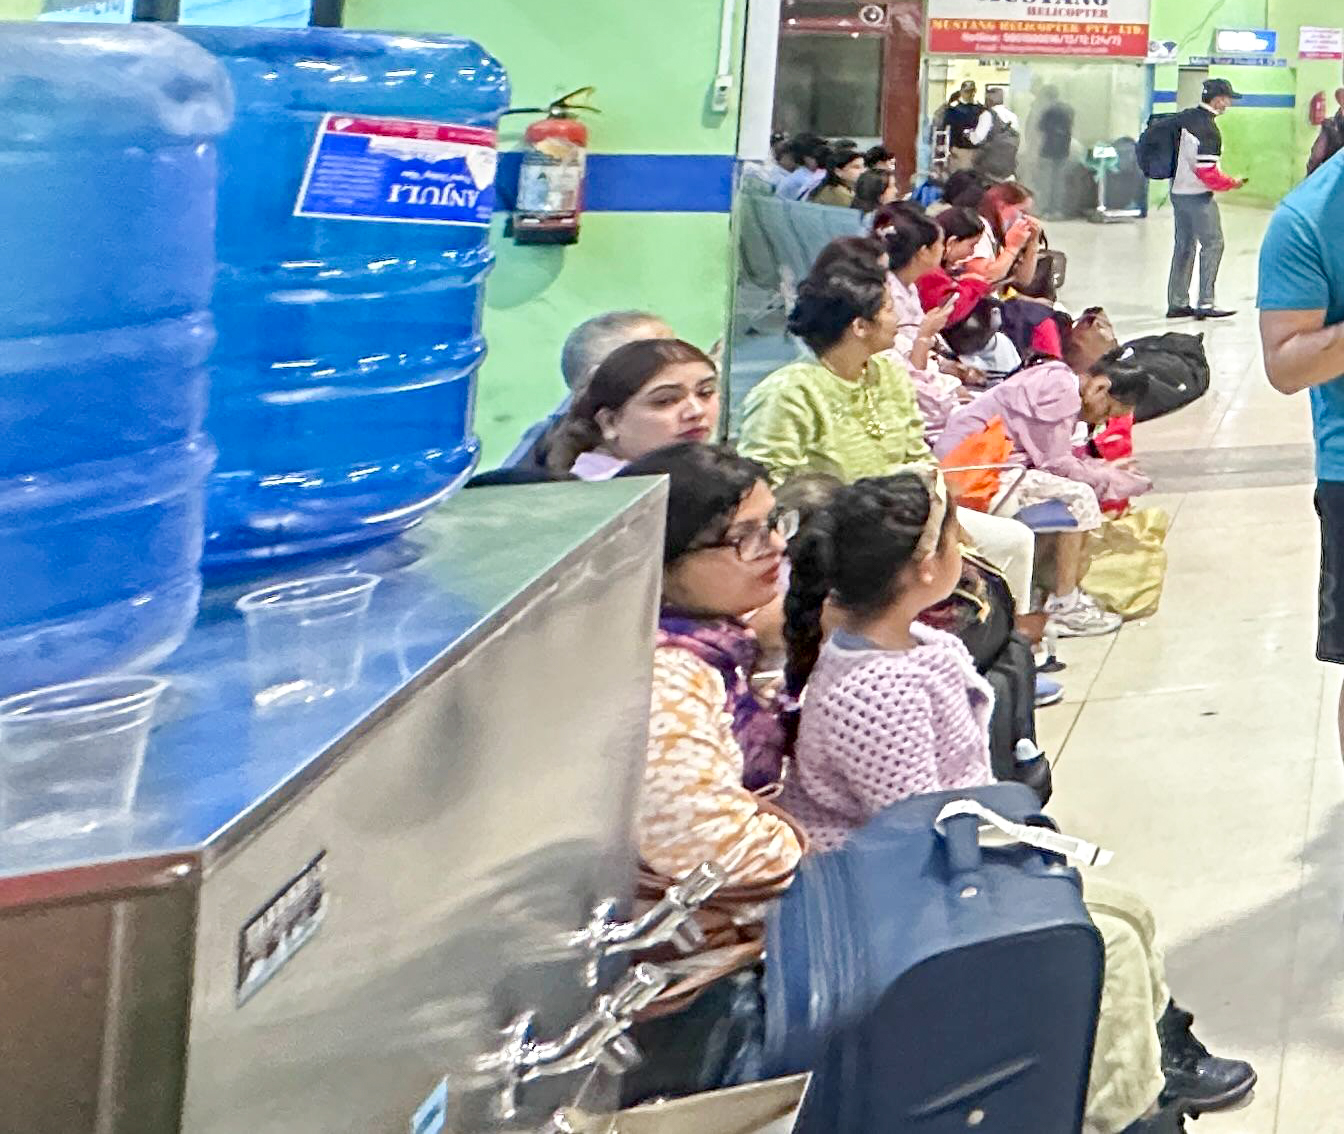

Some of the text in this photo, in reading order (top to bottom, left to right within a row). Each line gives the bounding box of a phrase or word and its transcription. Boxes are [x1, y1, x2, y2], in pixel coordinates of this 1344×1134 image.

[1027, 6, 1109, 18] HELICOPTER
[932, 20, 995, 31] MUSTANG
[1000, 21, 1078, 33] HELICOPTER
[387, 183, 481, 207] ANJULI
